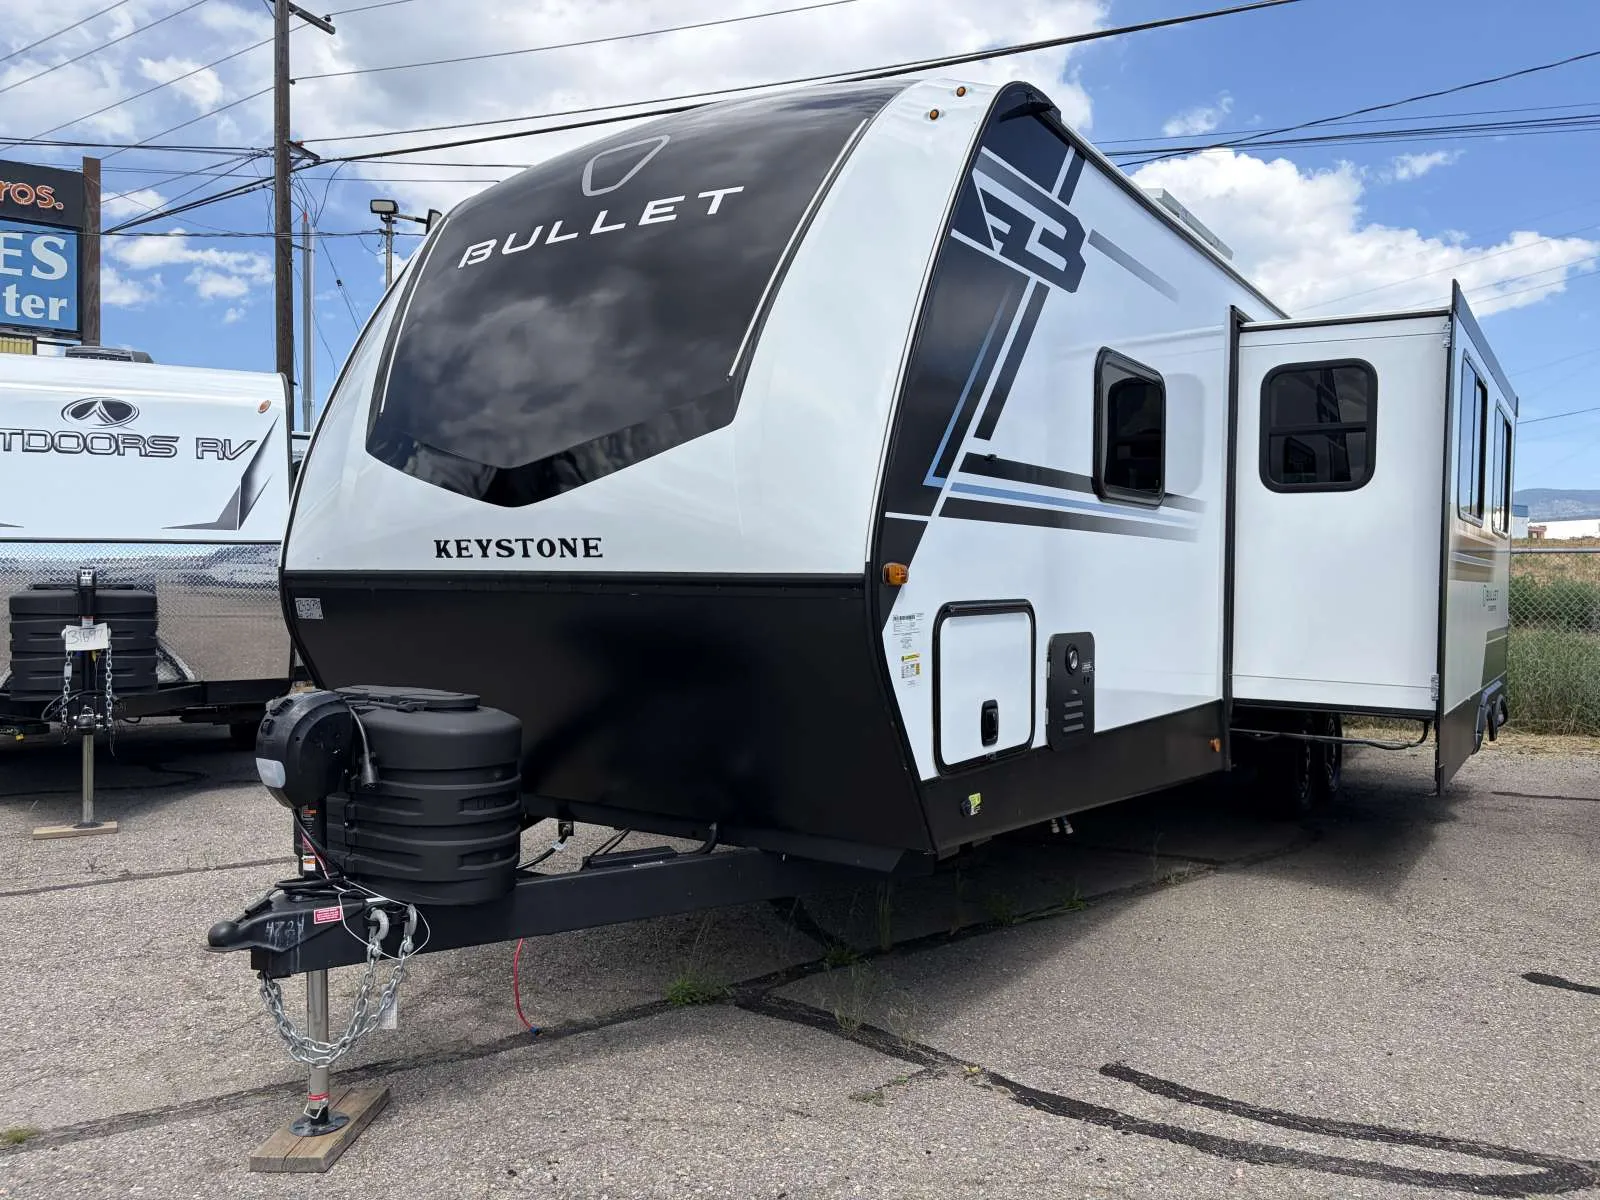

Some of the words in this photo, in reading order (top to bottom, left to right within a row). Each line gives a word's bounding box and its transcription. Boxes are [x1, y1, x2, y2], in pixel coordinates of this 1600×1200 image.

[457, 185, 745, 269] BULLET
[0, 232, 68, 280] ES
[2, 283, 68, 321] ter
[0, 428, 181, 458] TDOORS
[195, 437, 258, 461] RV
[433, 537, 604, 559] KEYSTONE
